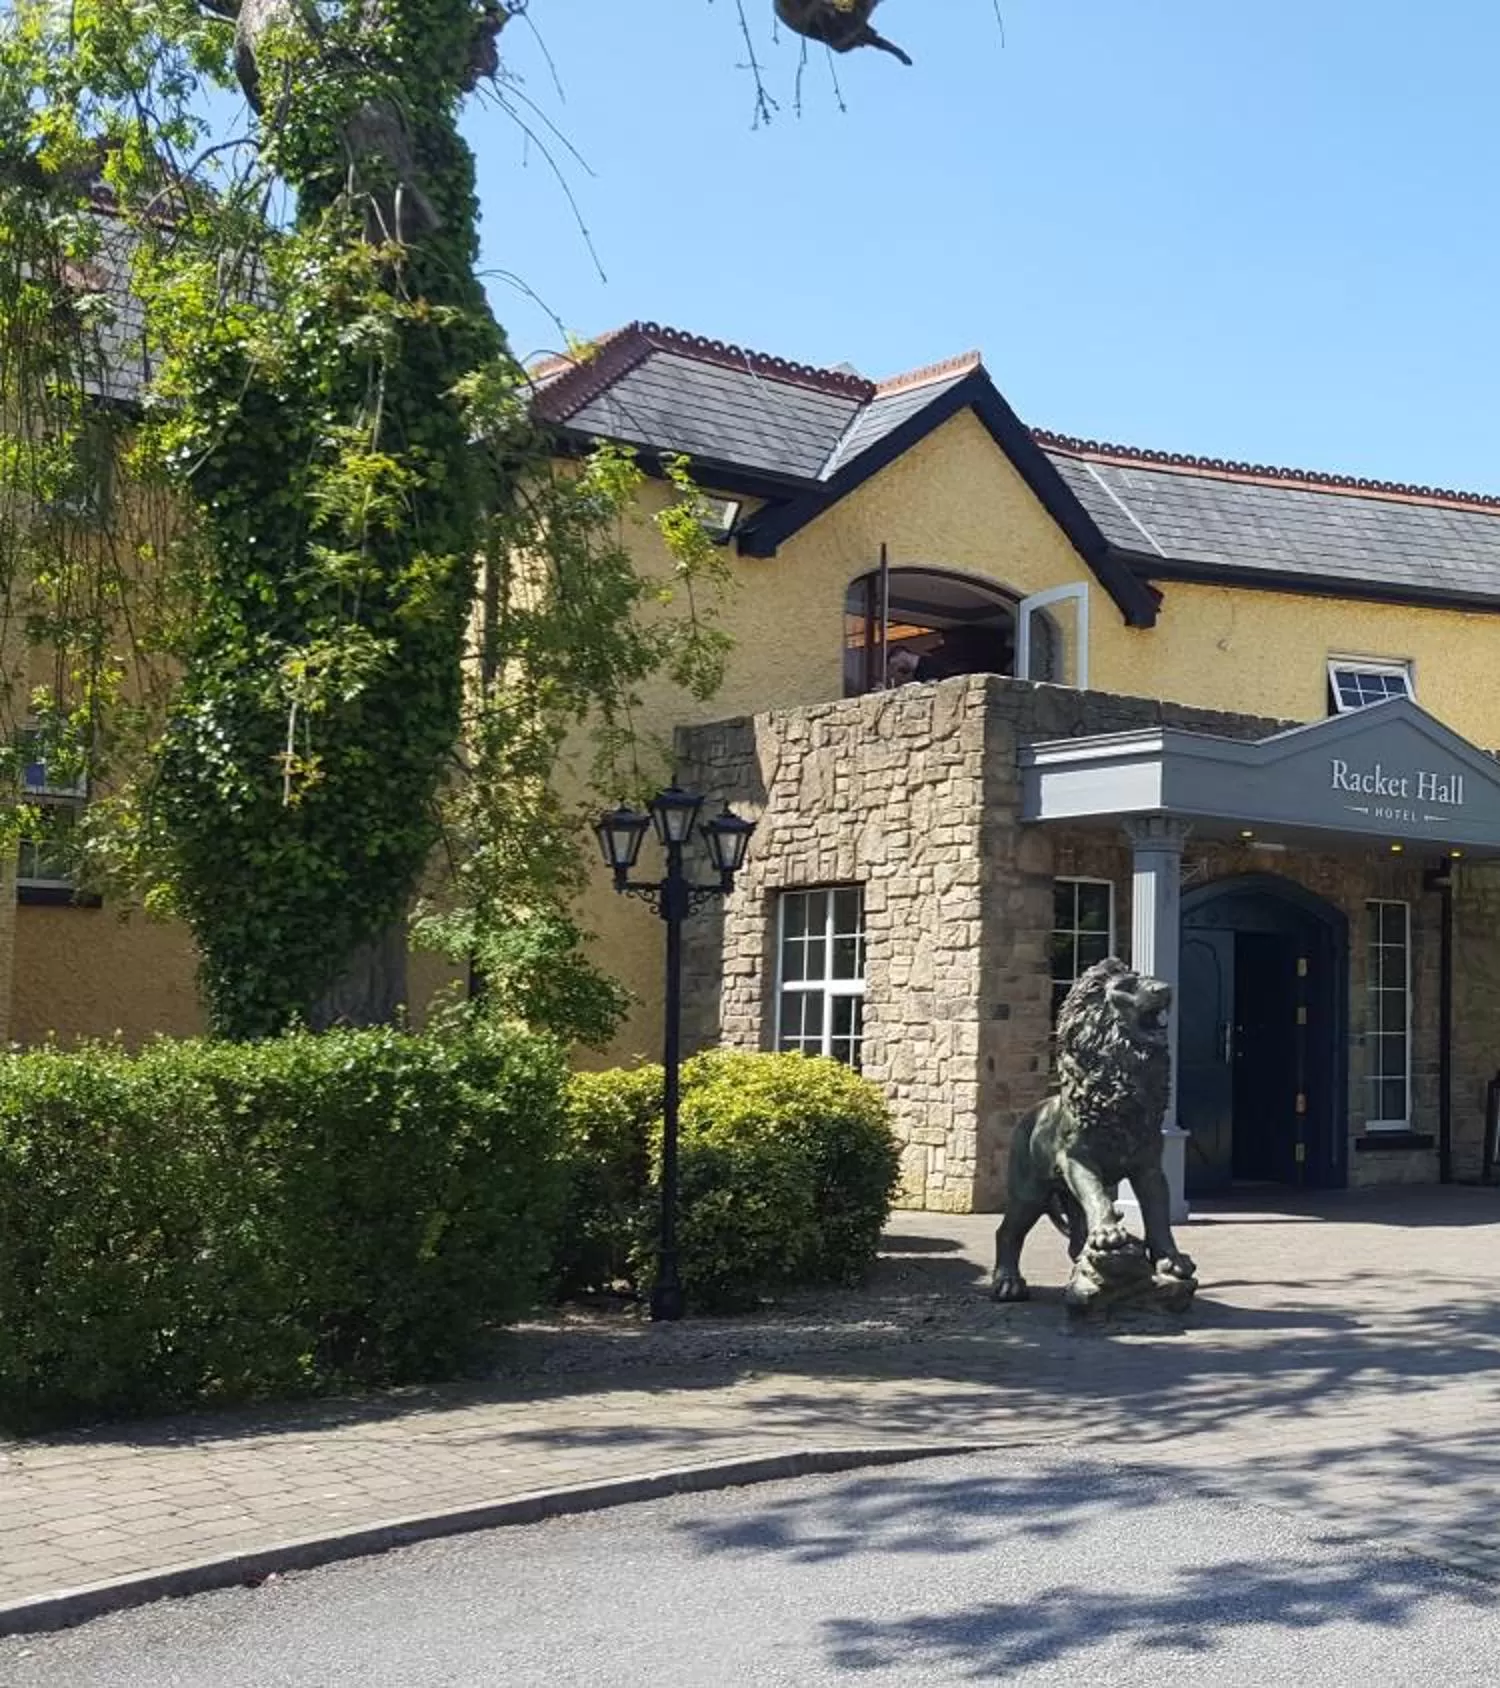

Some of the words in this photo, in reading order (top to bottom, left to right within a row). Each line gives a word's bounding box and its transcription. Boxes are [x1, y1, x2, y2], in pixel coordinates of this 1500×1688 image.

[1331, 759, 1408, 798] Racket
[1417, 771, 1463, 805] Hall
[1375, 807, 1418, 822] HOTEL
